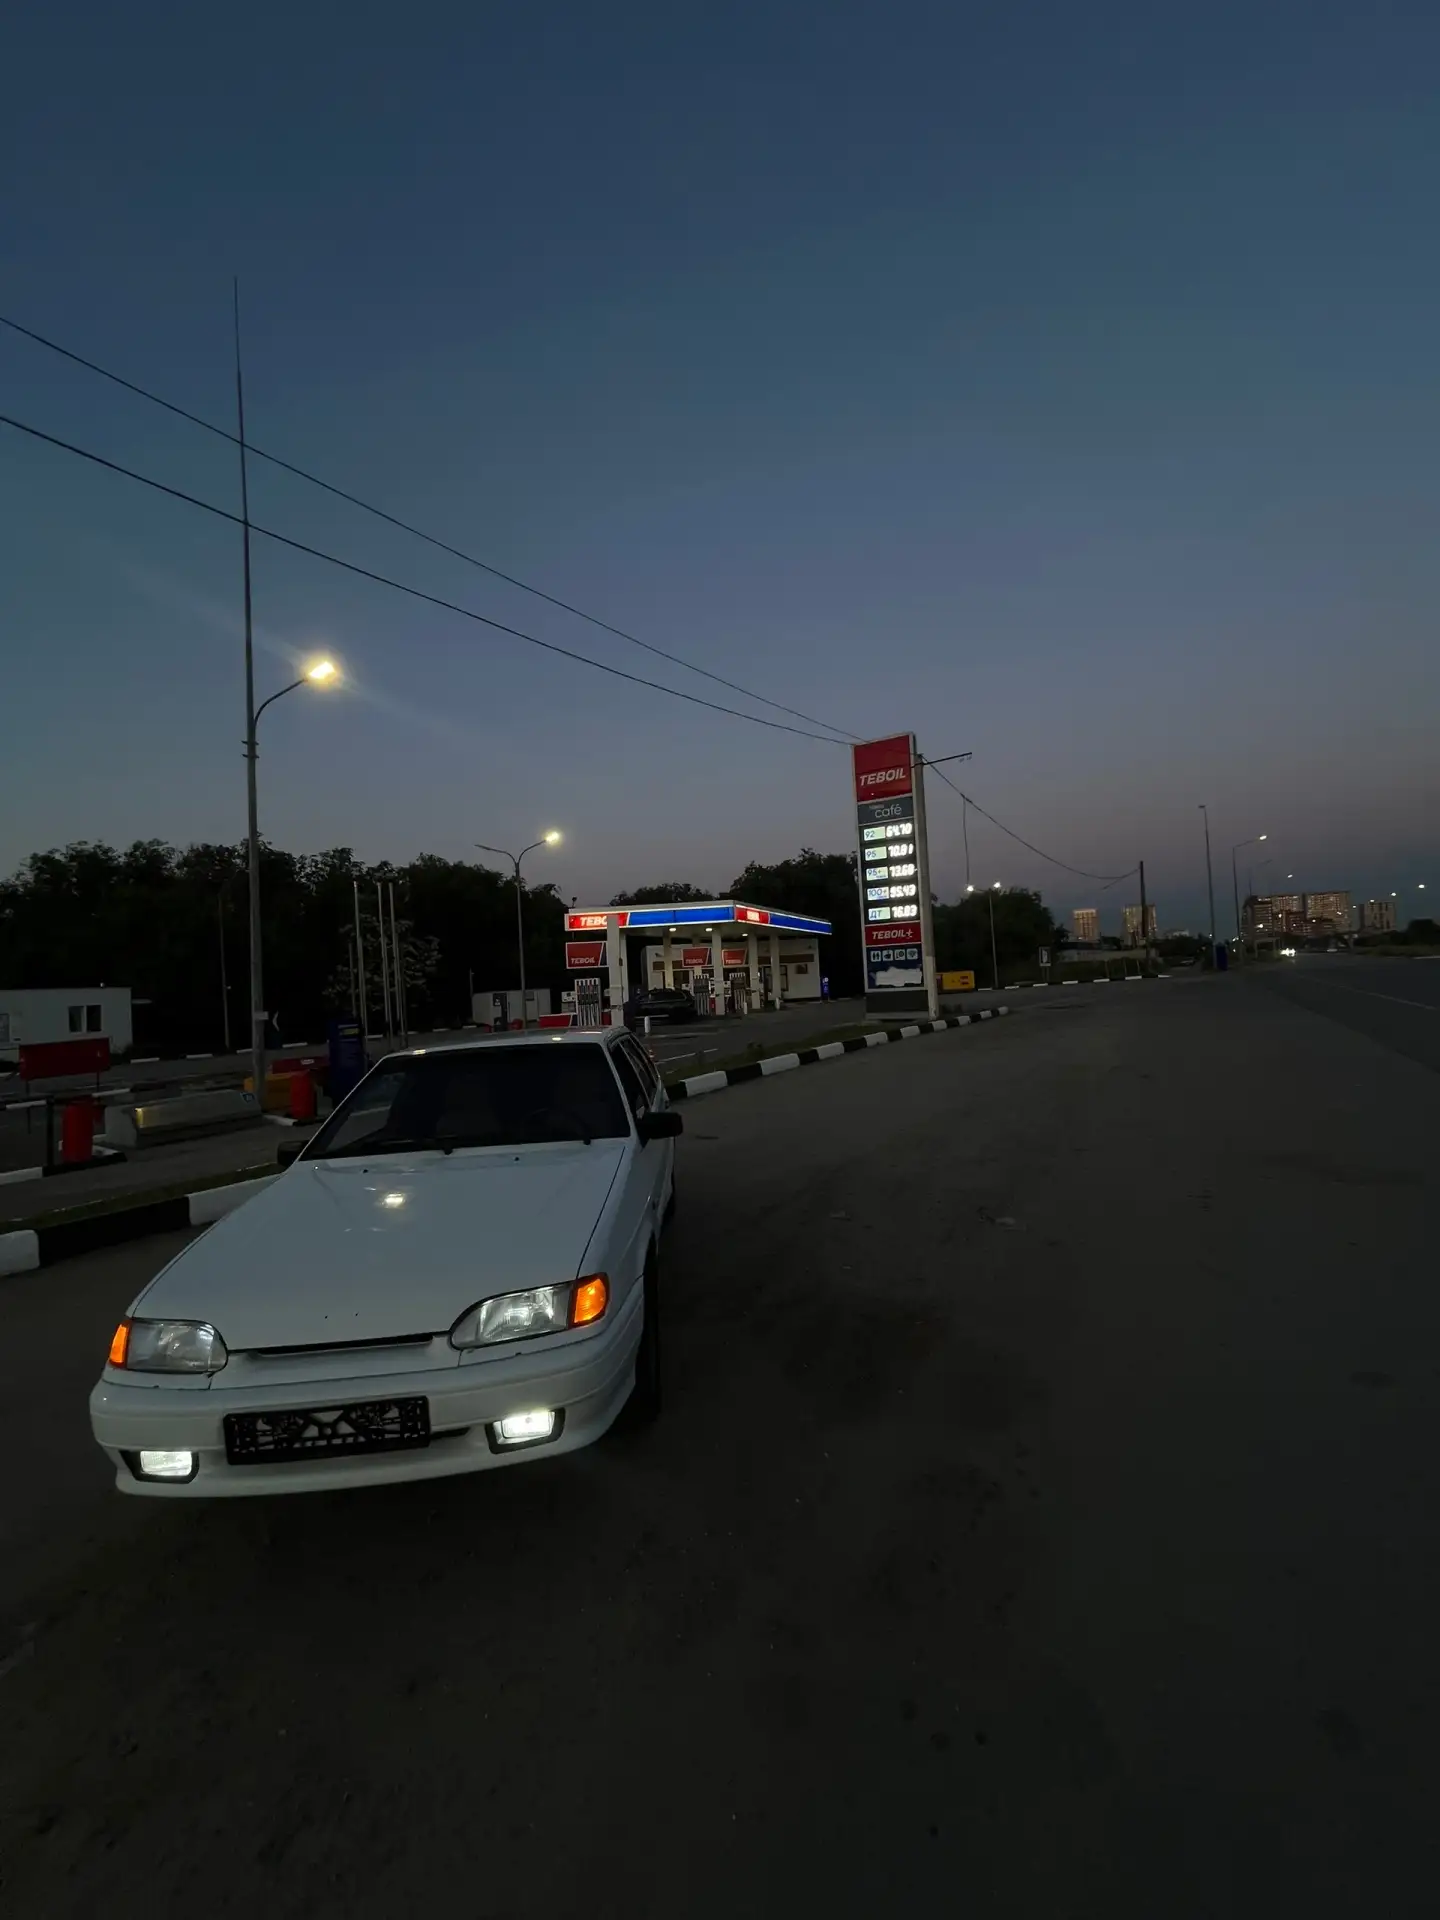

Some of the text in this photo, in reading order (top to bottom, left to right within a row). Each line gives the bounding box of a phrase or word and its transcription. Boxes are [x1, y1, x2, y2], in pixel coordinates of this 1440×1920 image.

[860, 768, 906, 786] TEBOIL
[874, 804, 902, 818] café
[865, 830, 876, 839] 92
[866, 850, 877, 859] 95
